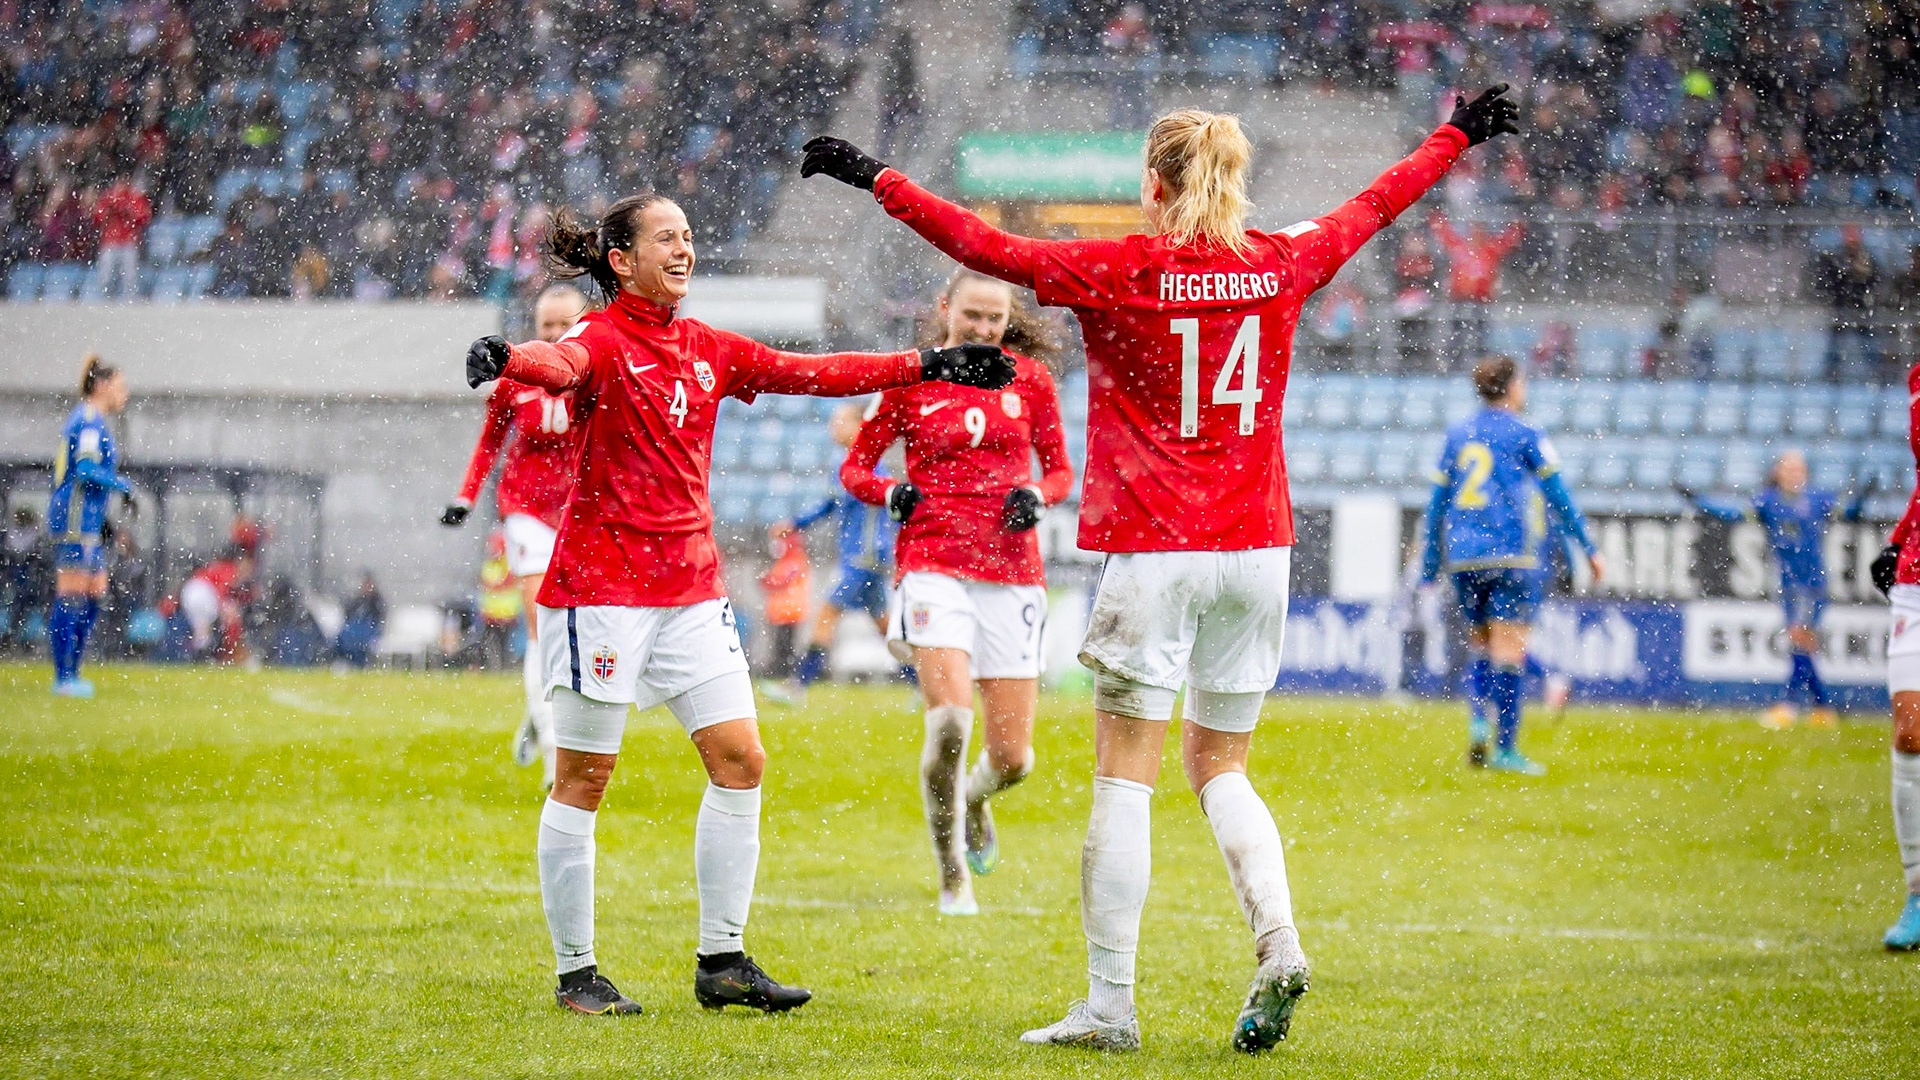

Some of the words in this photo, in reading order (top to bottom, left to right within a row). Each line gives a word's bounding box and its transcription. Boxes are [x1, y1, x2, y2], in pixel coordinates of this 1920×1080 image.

[1160, 271, 1279, 301] HEGERBERG
[1169, 314, 1264, 438] 14
[669, 379, 689, 428] 4
[964, 406, 986, 448] 9
[1455, 442, 1494, 509] 2
[1022, 603, 1037, 642] 9
